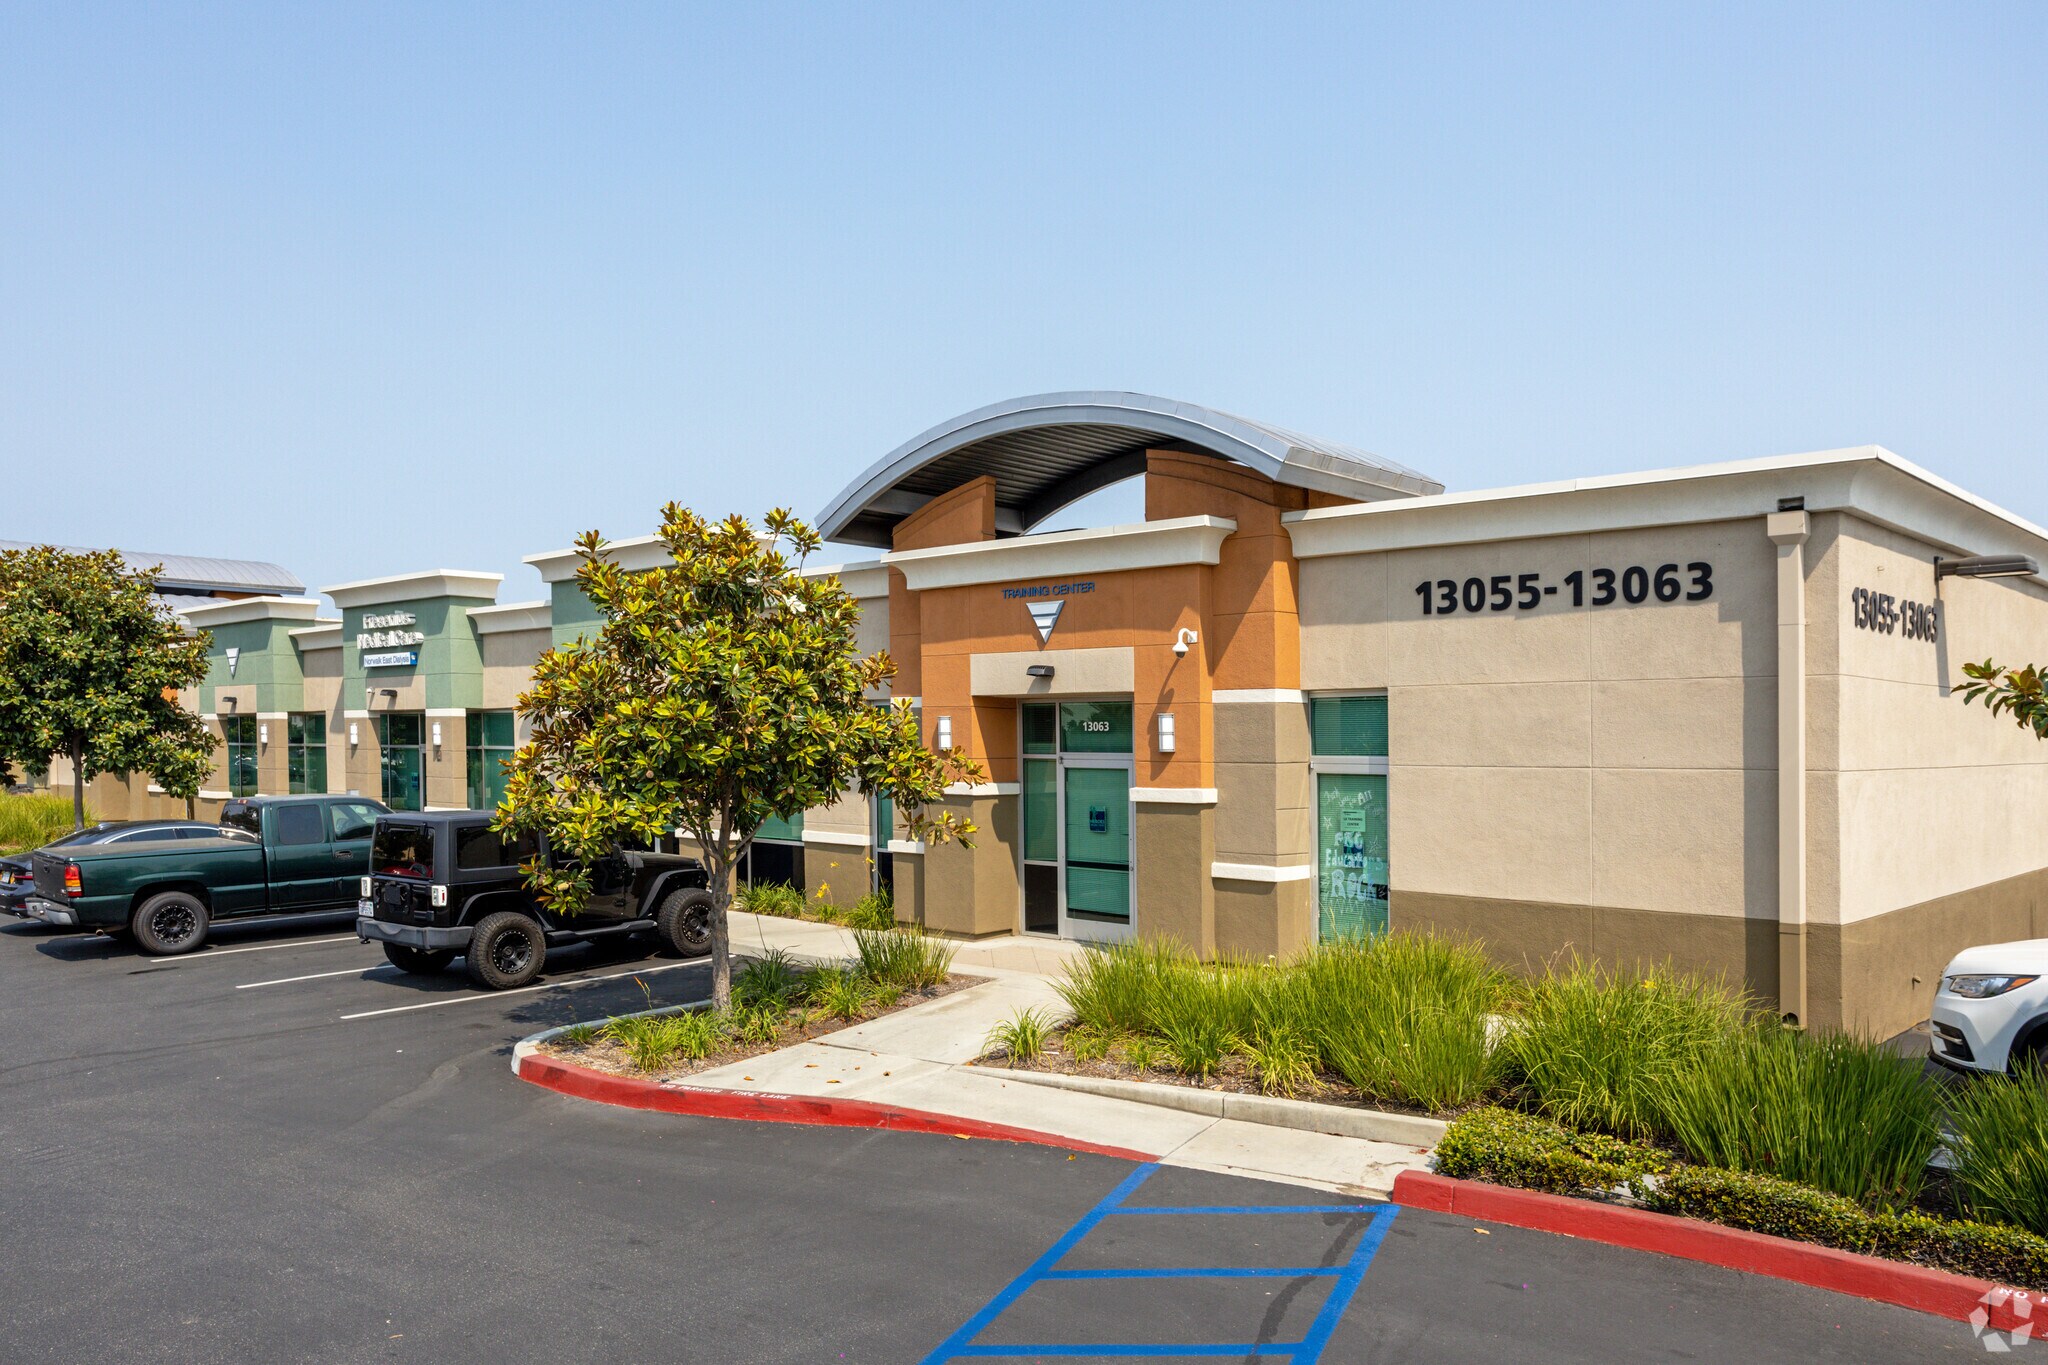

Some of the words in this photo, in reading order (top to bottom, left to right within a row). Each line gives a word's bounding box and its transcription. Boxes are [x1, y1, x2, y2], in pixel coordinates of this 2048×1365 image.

[1002, 586, 1050, 599] TRAINING
[1052, 582, 1095, 595] CENTER
[1415, 561, 1713, 615] 13055-13063
[1852, 587, 1939, 643] 13055-13063
[365, 657, 382, 665] Norwalk
[382, 656, 392, 664] East
[393, 655, 410, 664] Dialysis
[1082, 721, 1109, 731] 13063
[678, 1085, 723, 1093] PARKING
[1999, 1287, 2028, 1299] NO
